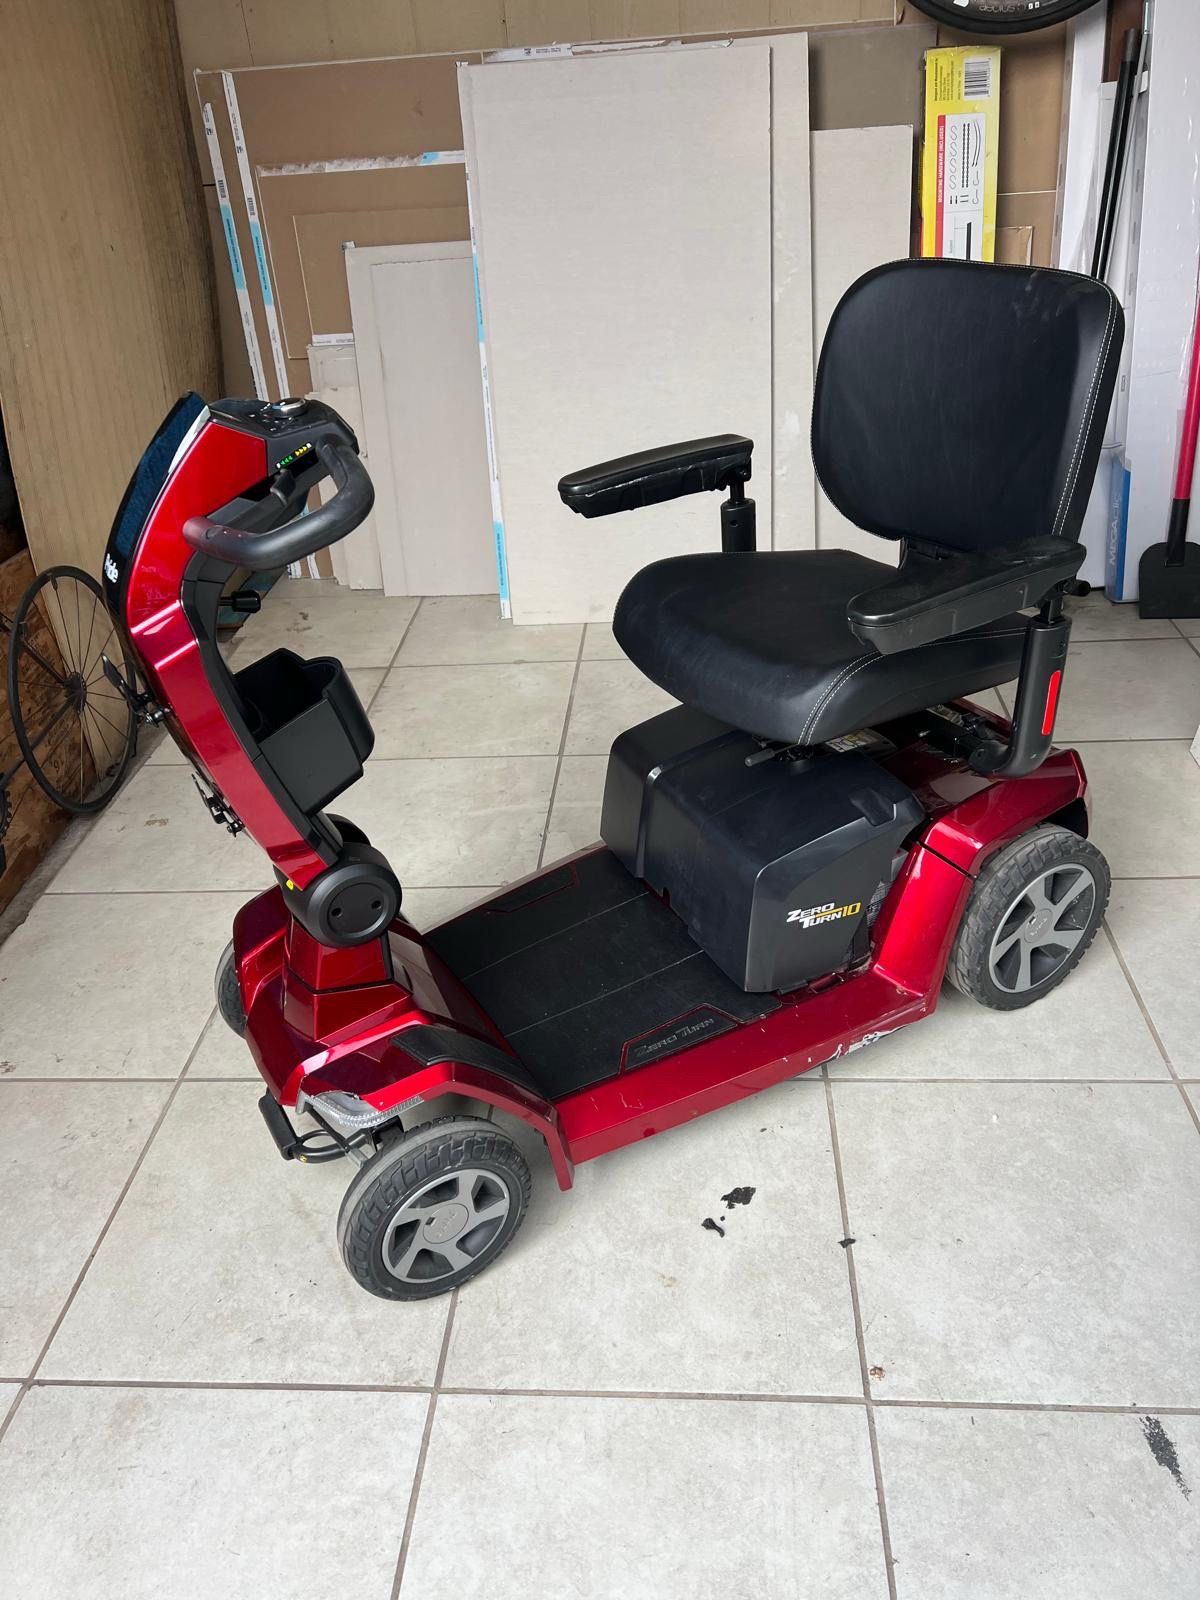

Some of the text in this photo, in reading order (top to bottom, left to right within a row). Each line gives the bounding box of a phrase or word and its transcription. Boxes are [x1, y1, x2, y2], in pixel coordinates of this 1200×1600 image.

[786, 902, 836, 923] ZERO
[634, 1018, 715, 1057] ZERO TURN
